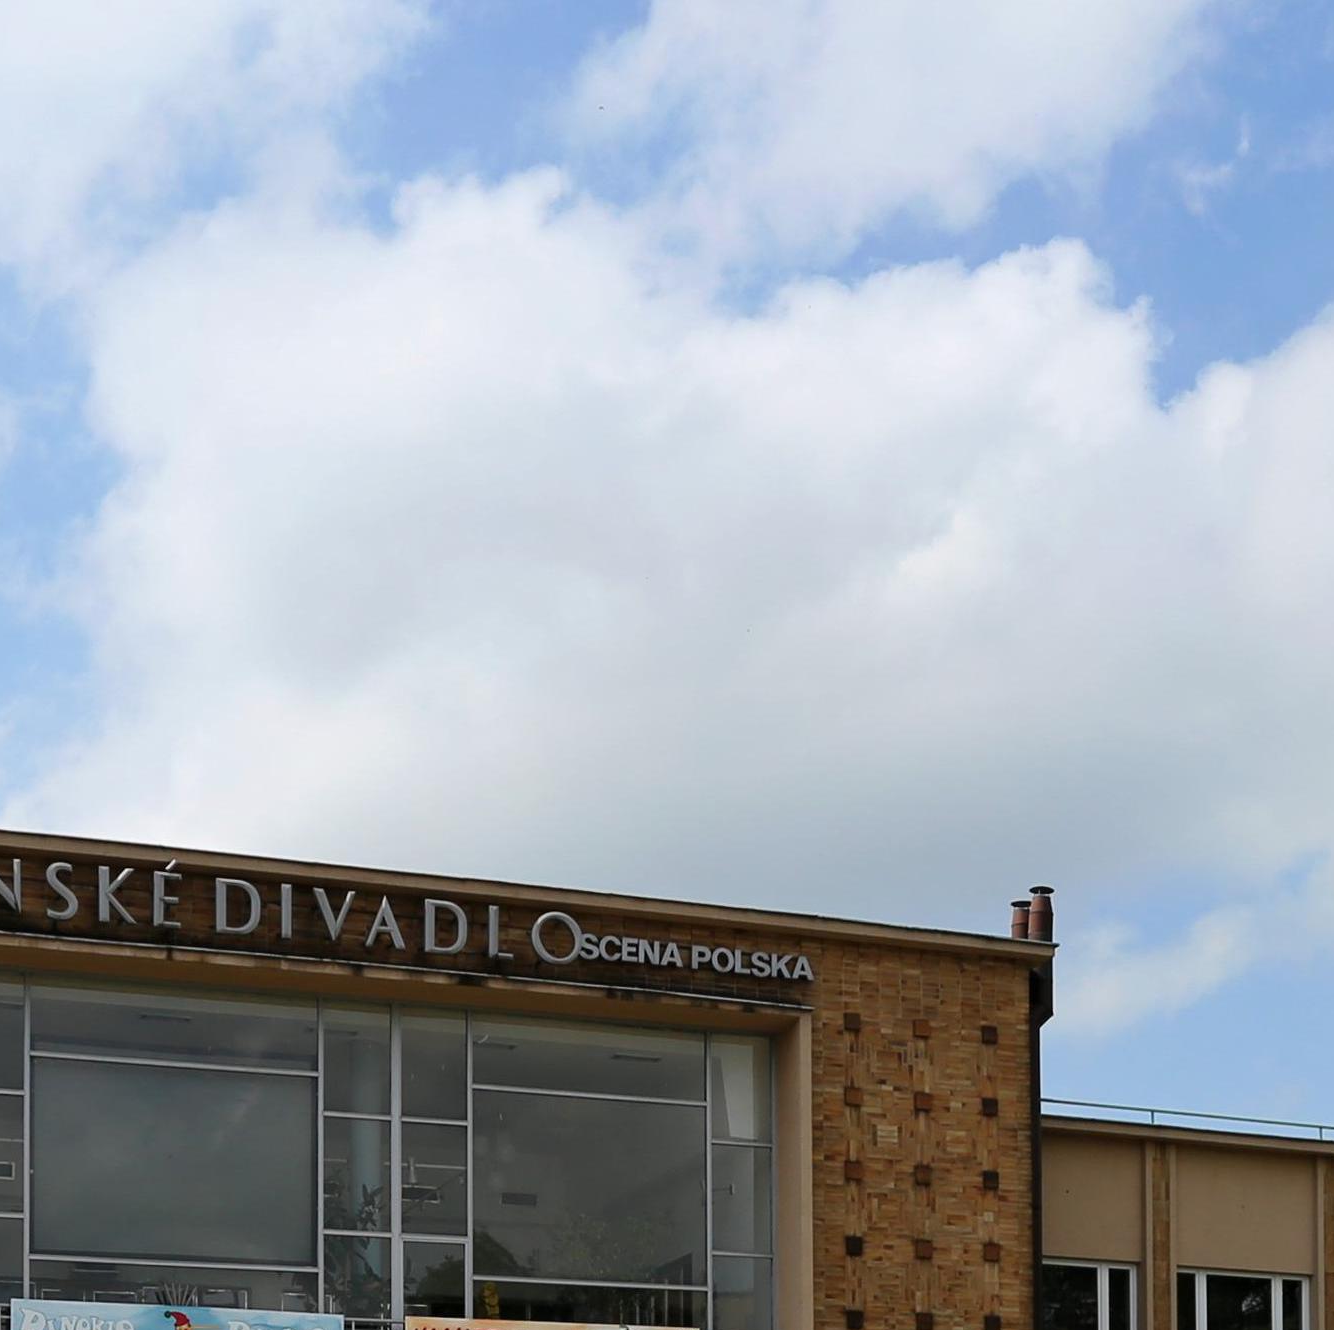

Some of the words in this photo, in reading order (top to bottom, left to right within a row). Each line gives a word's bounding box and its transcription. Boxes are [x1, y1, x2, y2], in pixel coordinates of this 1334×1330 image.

[214, 876, 581, 965] DIVADLO
[579, 932, 683, 969] SCENA
[690, 945, 815, 981] POLSKA
